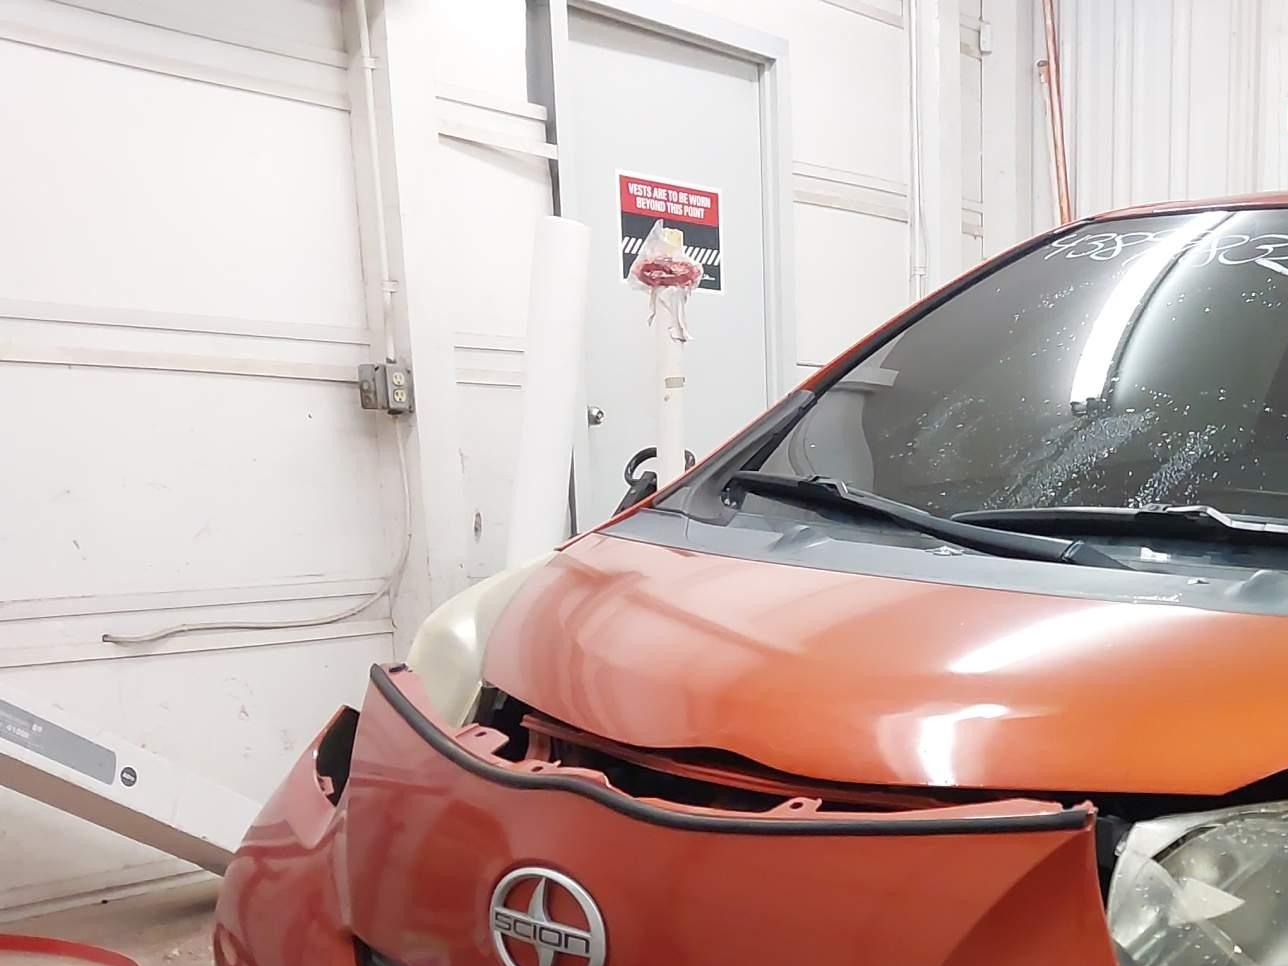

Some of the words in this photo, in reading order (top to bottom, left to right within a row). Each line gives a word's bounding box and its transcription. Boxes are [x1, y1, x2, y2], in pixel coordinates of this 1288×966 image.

[627, 182, 652, 197] VESTS
[653, 187, 667, 200] ARE
[667, 190, 678, 202] TO
[678, 192, 689, 204] BE
[689, 194, 711, 208] WORN
[636, 196, 666, 212] BEYOND
[667, 201, 683, 216] THIS
[683, 205, 705, 219] POINT
